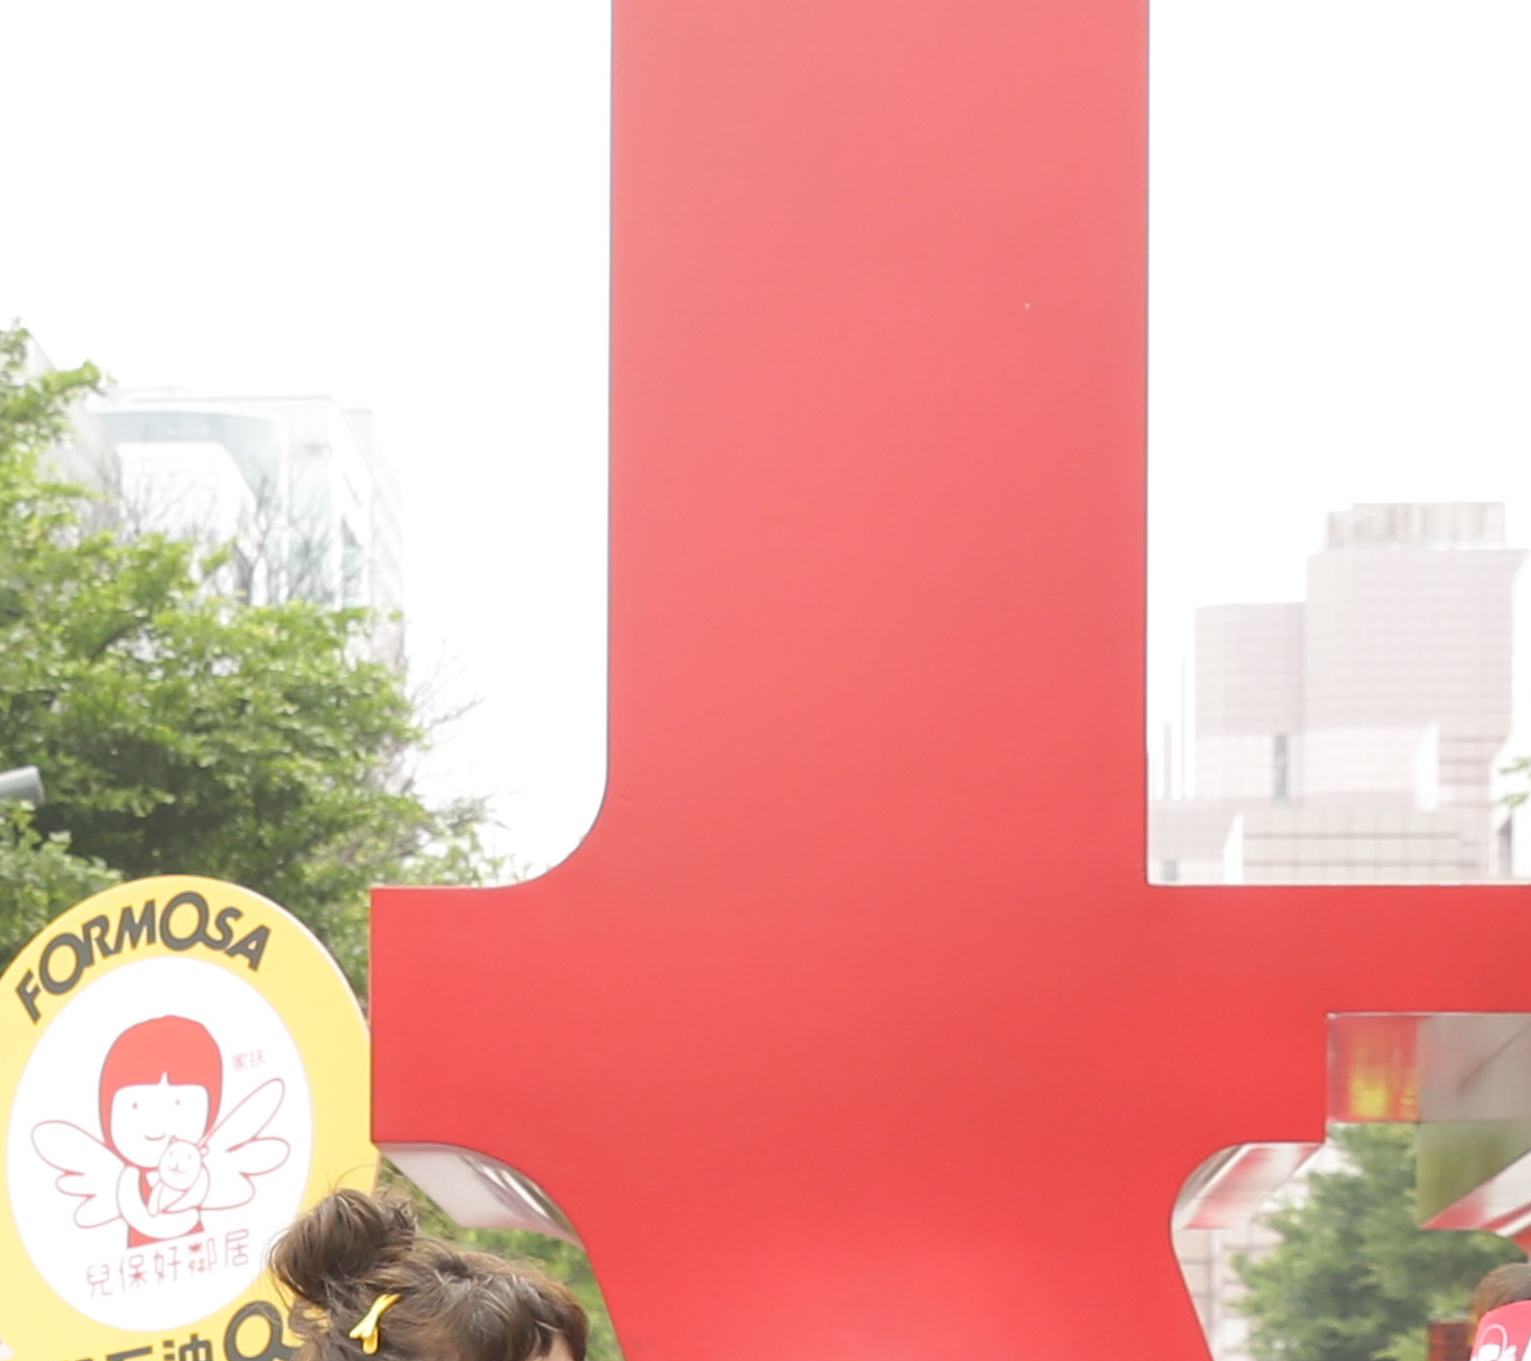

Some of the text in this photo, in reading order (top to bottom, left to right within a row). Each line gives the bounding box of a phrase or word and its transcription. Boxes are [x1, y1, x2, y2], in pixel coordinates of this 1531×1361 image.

[15, 891, 272, 1026] FORMOSA
[87, 1228, 250, 1298] 兒保好鄰居
